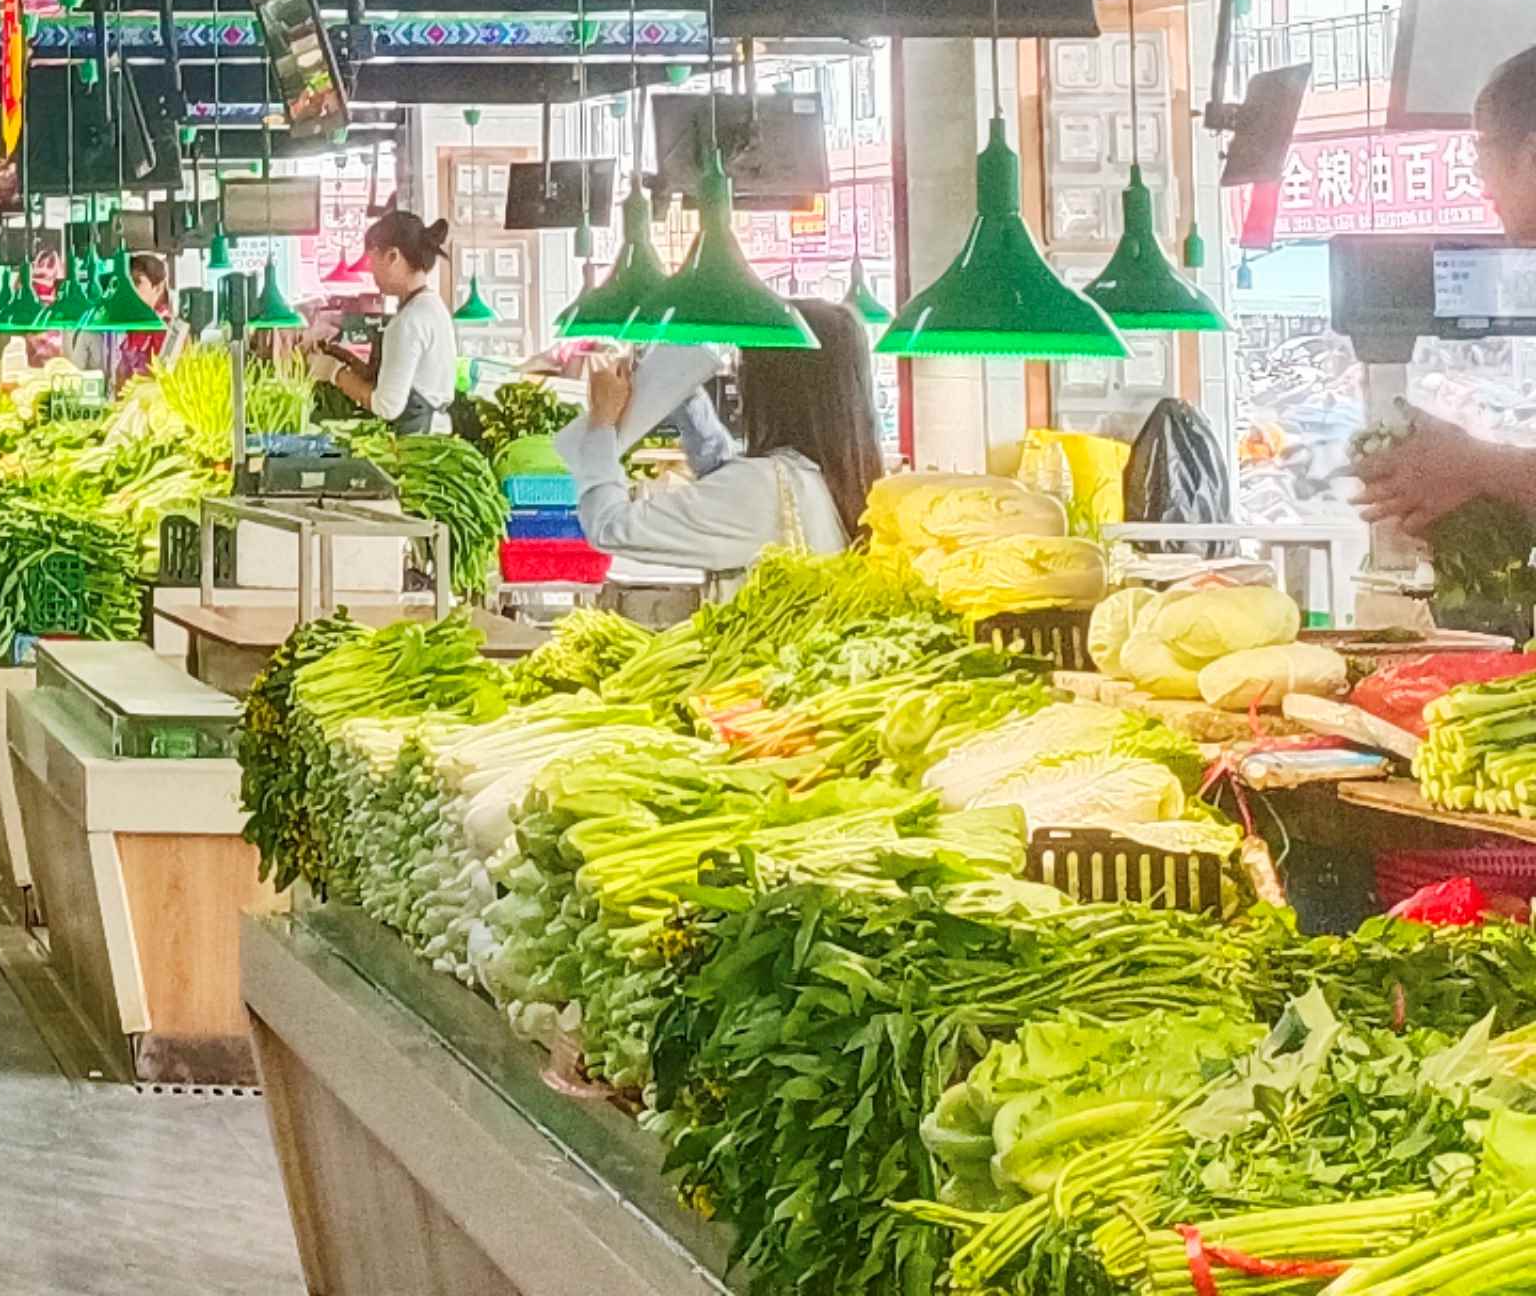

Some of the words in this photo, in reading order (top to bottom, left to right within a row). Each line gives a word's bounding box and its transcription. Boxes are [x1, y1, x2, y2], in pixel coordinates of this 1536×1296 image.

[1281, 135, 1482, 208] 全粮油百货
